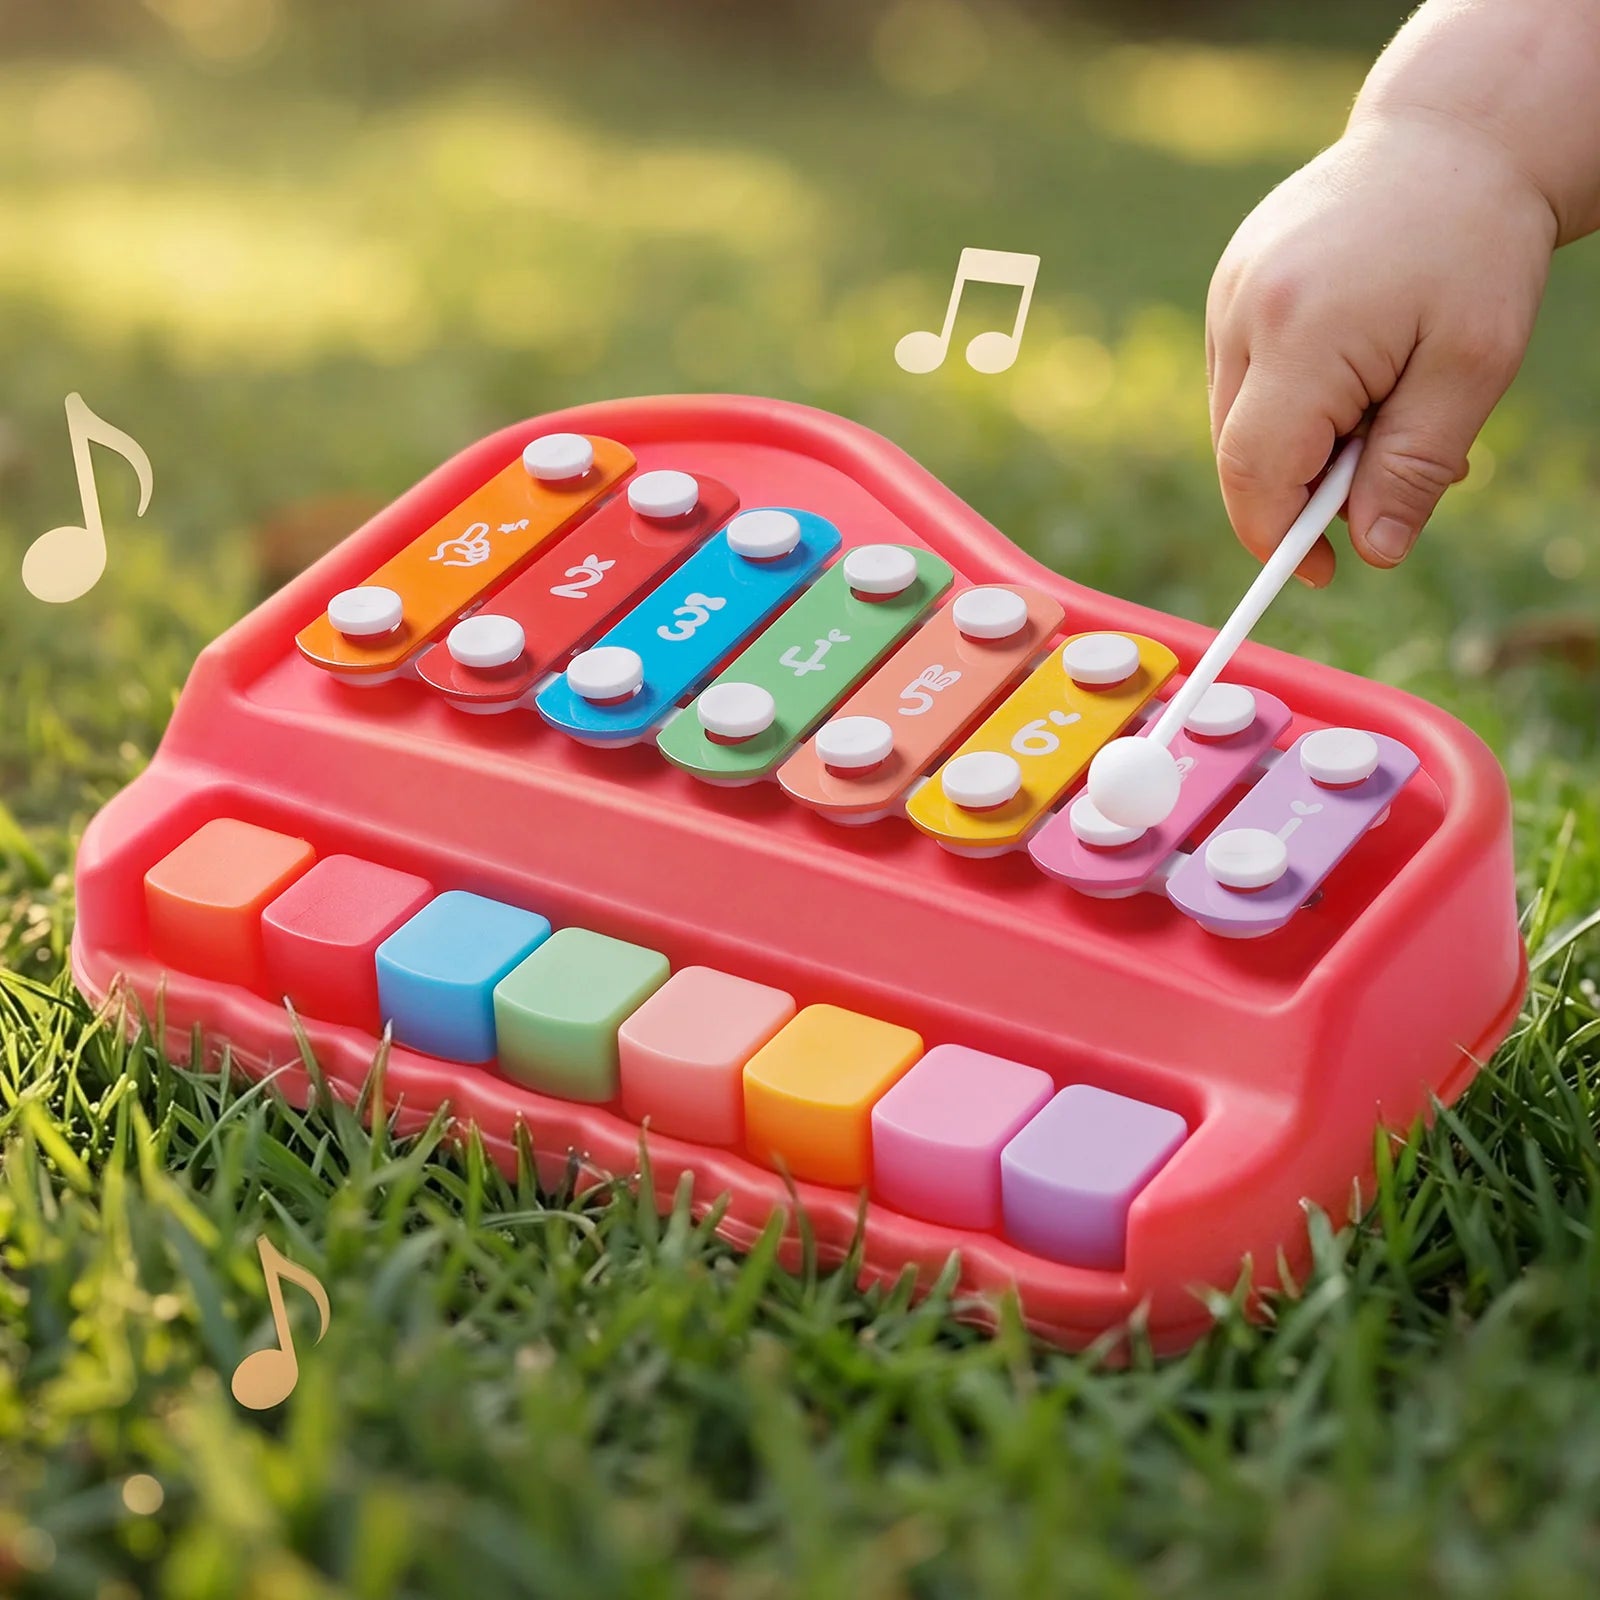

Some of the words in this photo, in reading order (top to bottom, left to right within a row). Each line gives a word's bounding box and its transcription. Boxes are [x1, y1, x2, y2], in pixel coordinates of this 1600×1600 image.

[550, 566, 604, 598] 2
[657, 605, 709, 641] 3
[779, 639, 832, 676] 4
[898, 678, 945, 716] 5
[1010, 719, 1060, 756] 6
